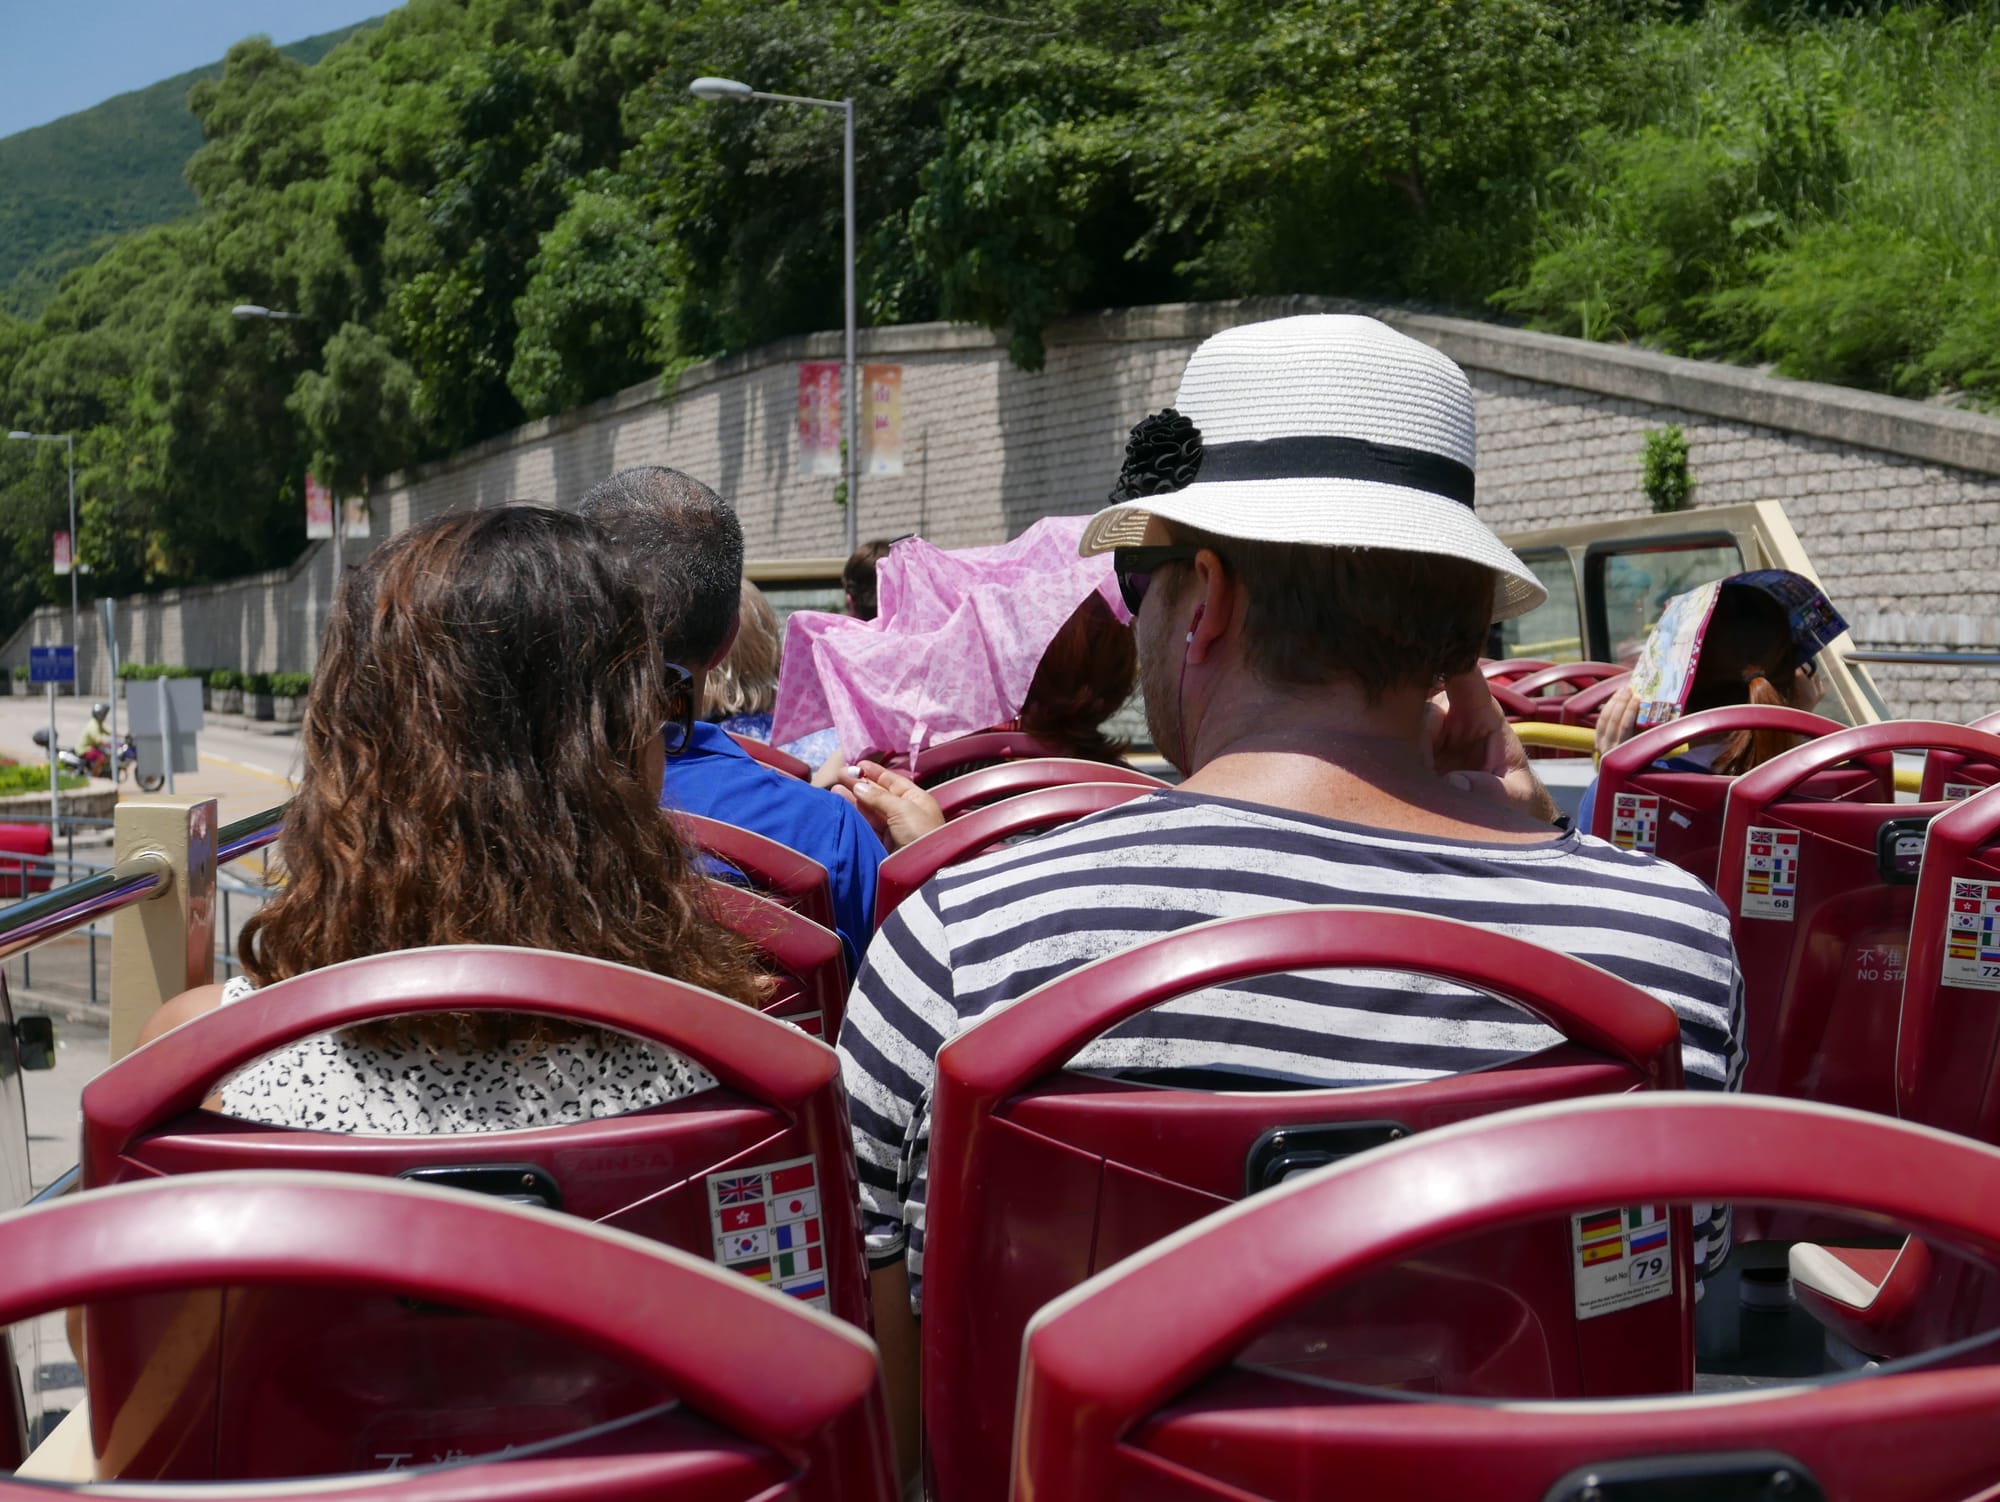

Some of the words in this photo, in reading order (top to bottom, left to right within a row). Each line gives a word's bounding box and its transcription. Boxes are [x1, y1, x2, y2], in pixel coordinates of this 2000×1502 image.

[1774, 899, 1789, 908] 68
[1857, 969, 1879, 981] NO
[1983, 966, 2000, 977] 72
[765, 1172, 770, 1180] 2
[714, 1210, 720, 1218] 3
[1636, 1258, 1663, 1280] 79
